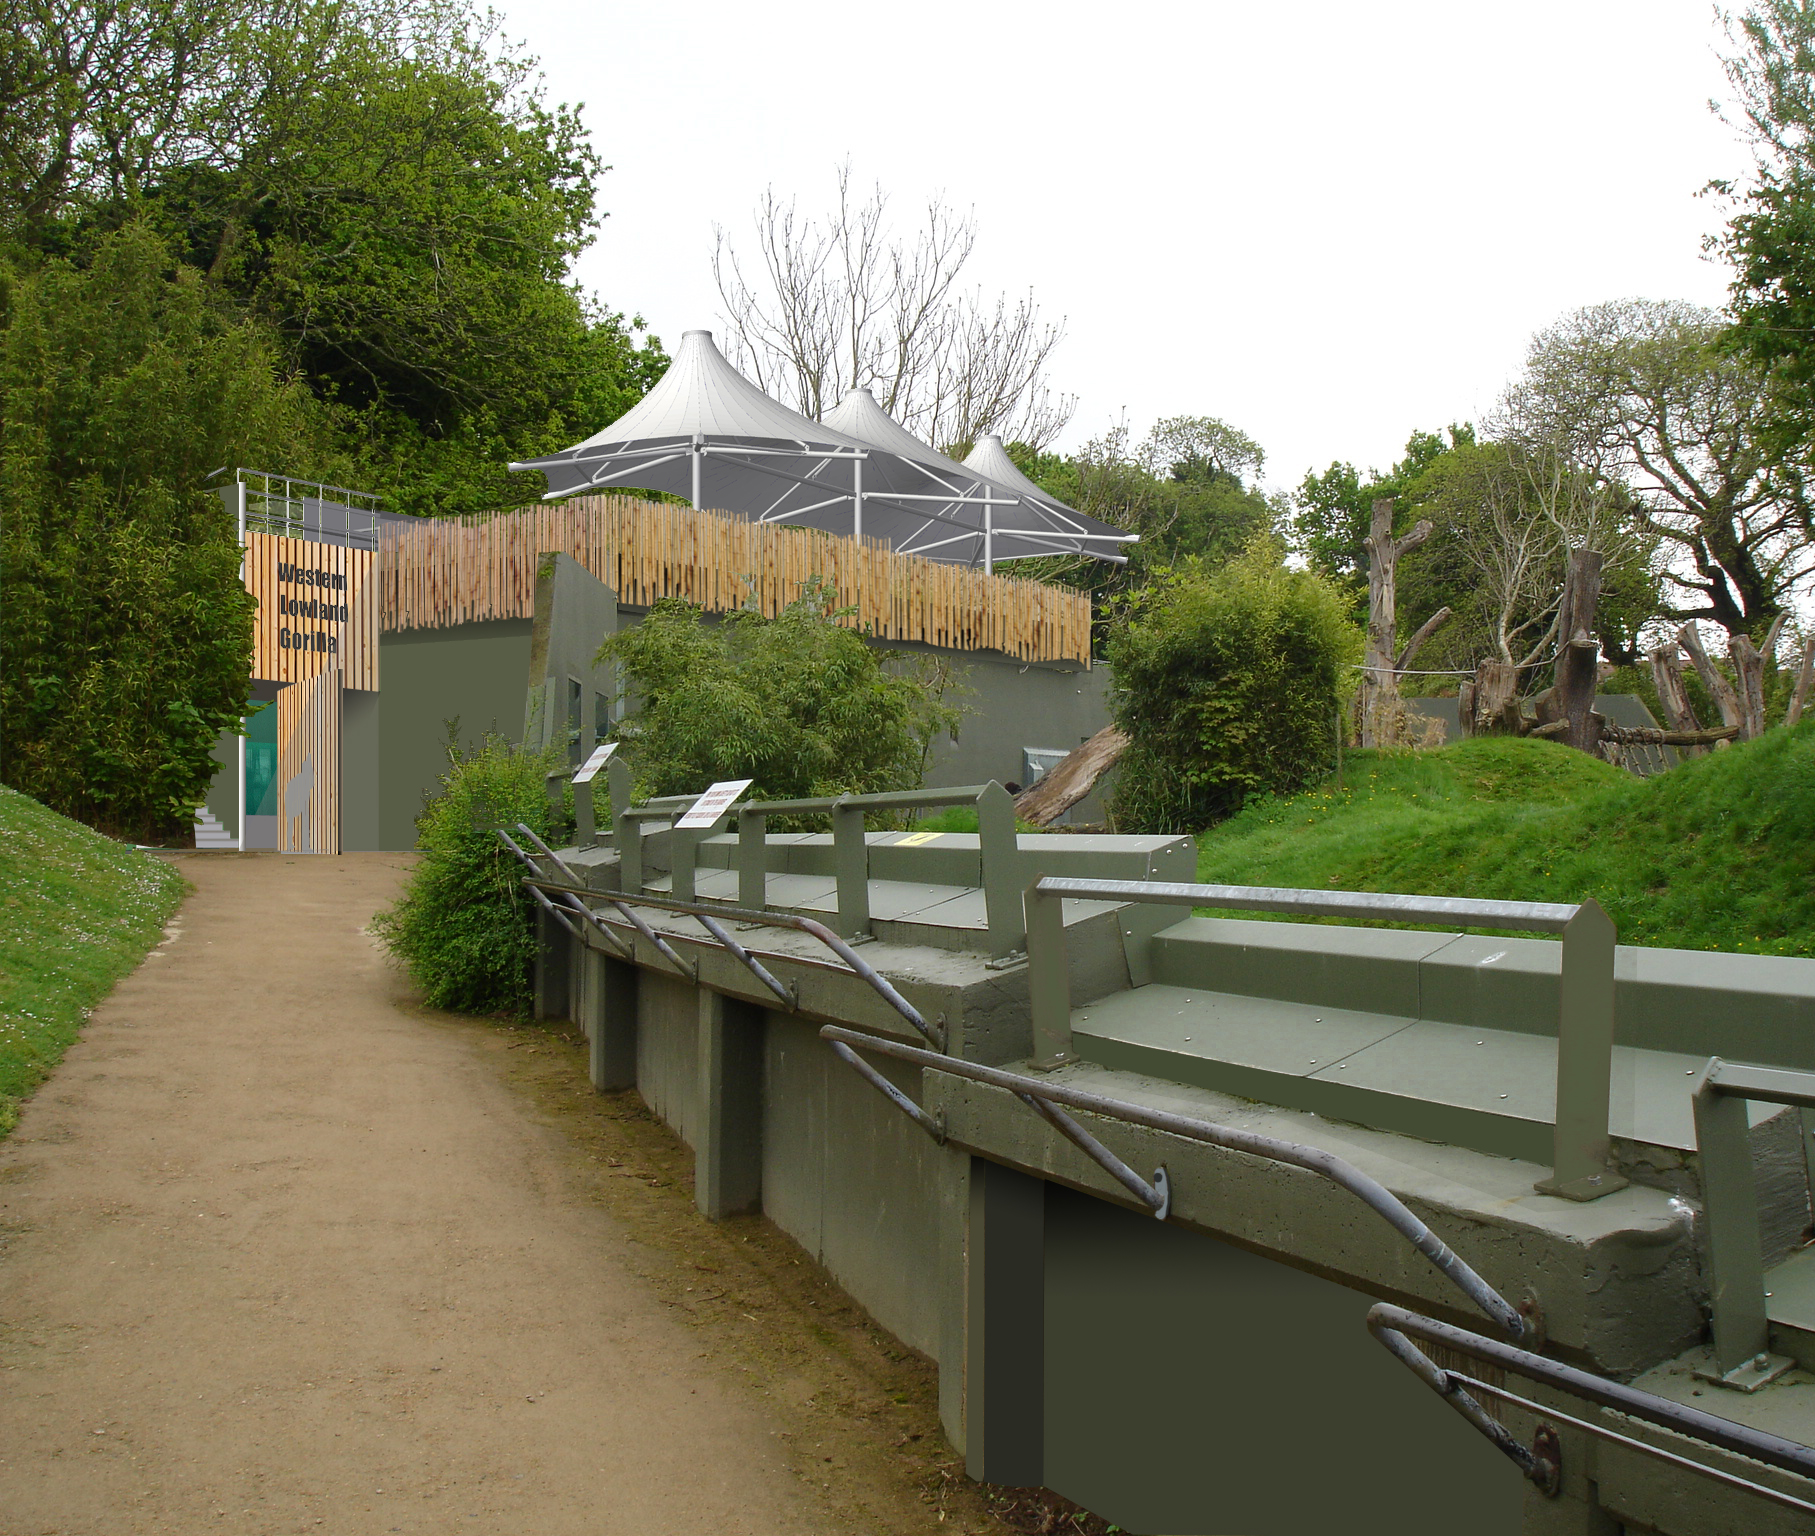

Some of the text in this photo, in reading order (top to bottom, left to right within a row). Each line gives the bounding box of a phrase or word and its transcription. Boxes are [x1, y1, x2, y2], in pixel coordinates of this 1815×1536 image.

[278, 562, 347, 591] Western
[281, 594, 348, 623] Lowland
[280, 627, 337, 653] Gorilla
